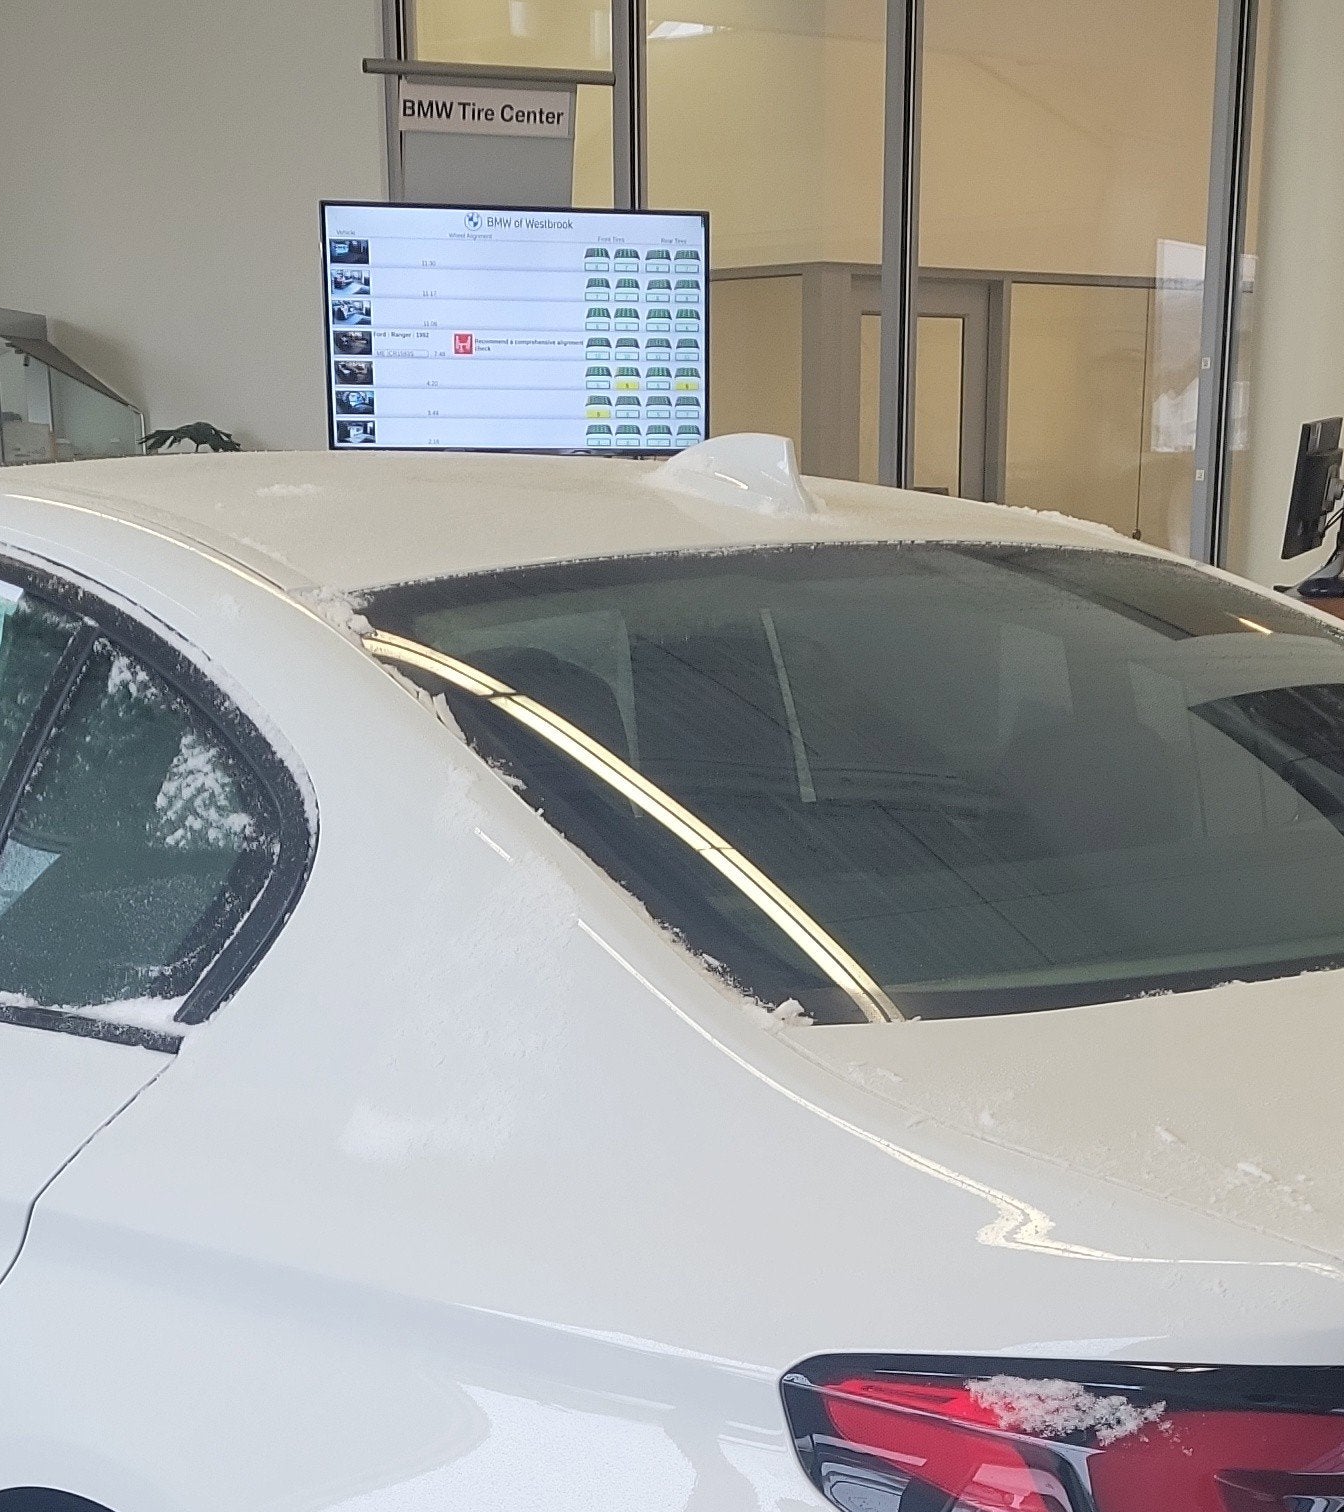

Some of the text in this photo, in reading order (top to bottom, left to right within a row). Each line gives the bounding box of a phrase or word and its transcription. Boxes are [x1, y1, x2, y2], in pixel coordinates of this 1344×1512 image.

[402, 99, 564, 125] BMW Tire Center
[487, 217, 573, 230] BMW of Westbrook
